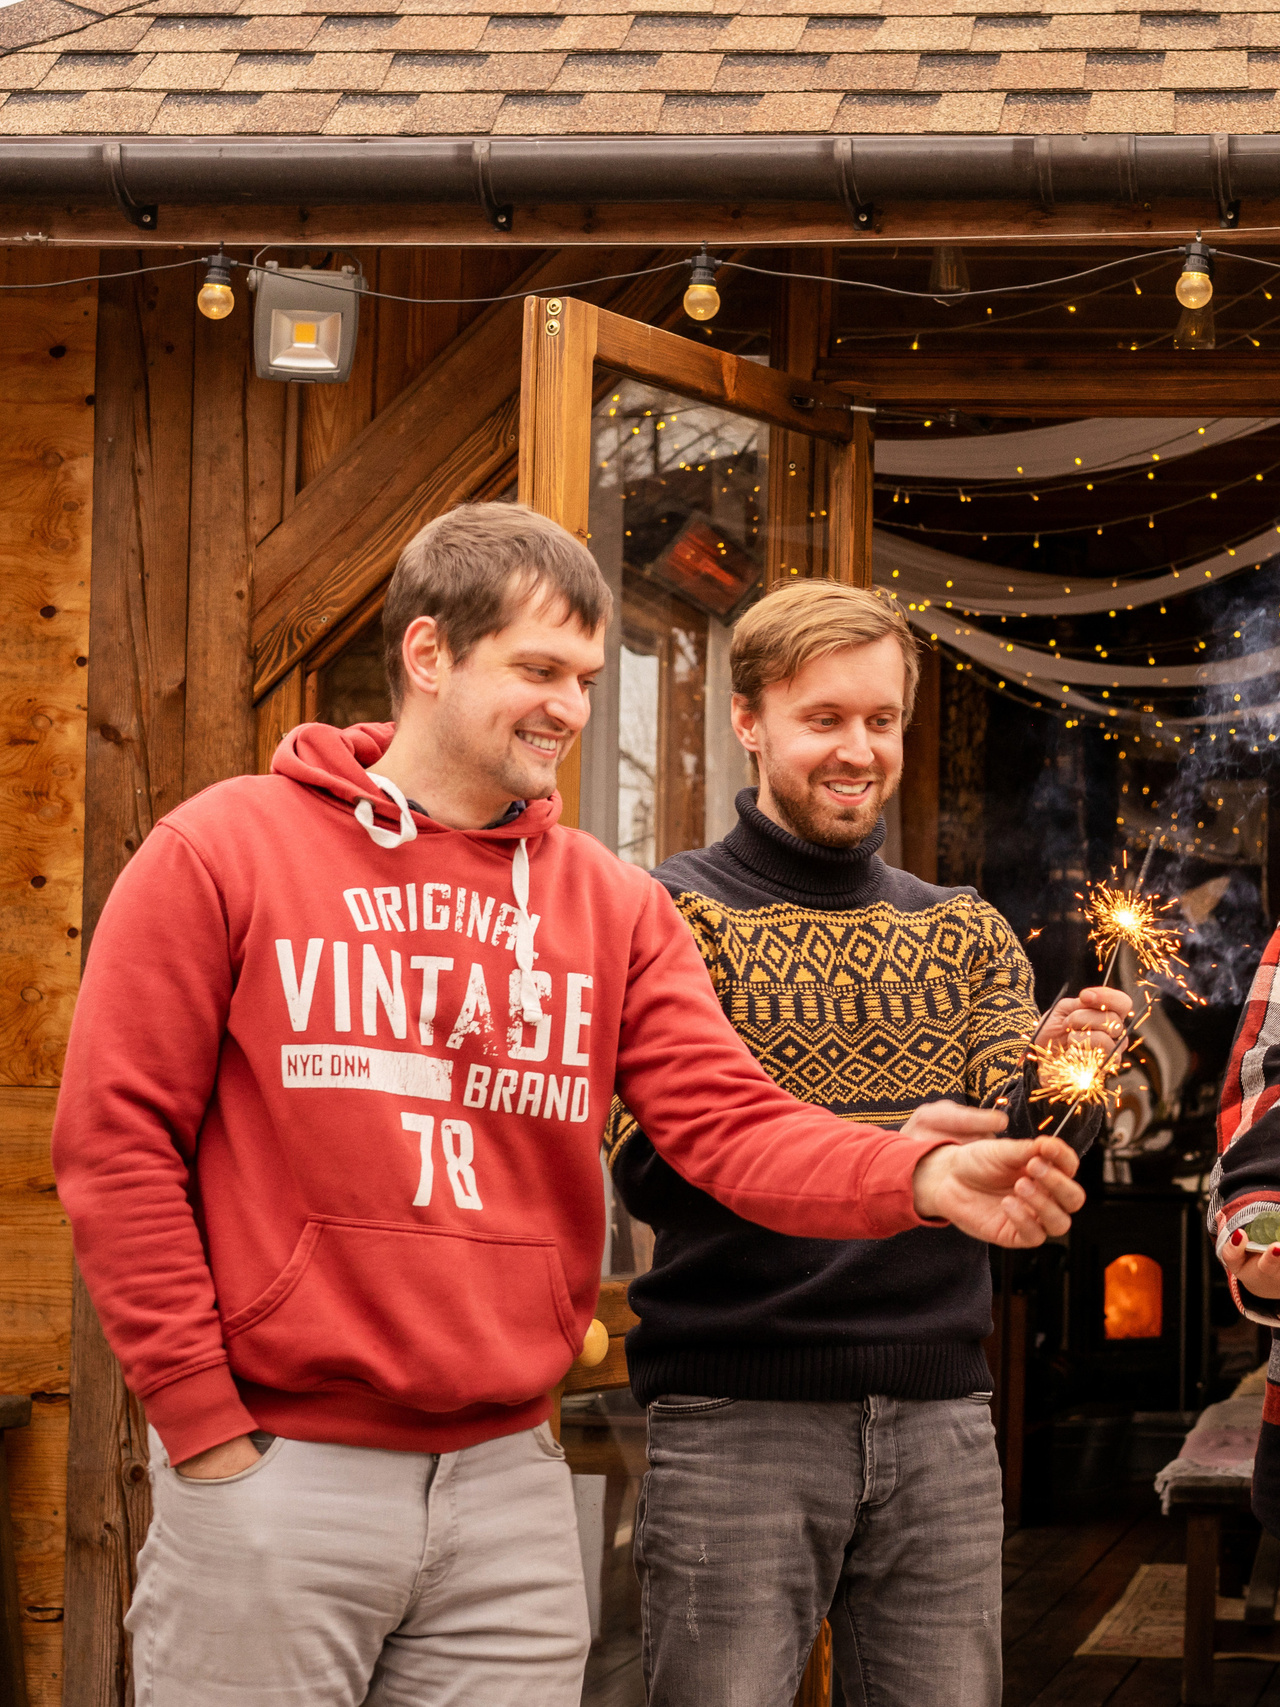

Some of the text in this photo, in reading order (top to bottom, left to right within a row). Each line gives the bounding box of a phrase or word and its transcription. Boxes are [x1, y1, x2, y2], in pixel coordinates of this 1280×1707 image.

[275, 938, 594, 1067] VINTAGE
[287, 1054, 370, 1078] NYC DNM
[463, 1063, 589, 1122] BRAND
[400, 1112, 483, 1210] 78
